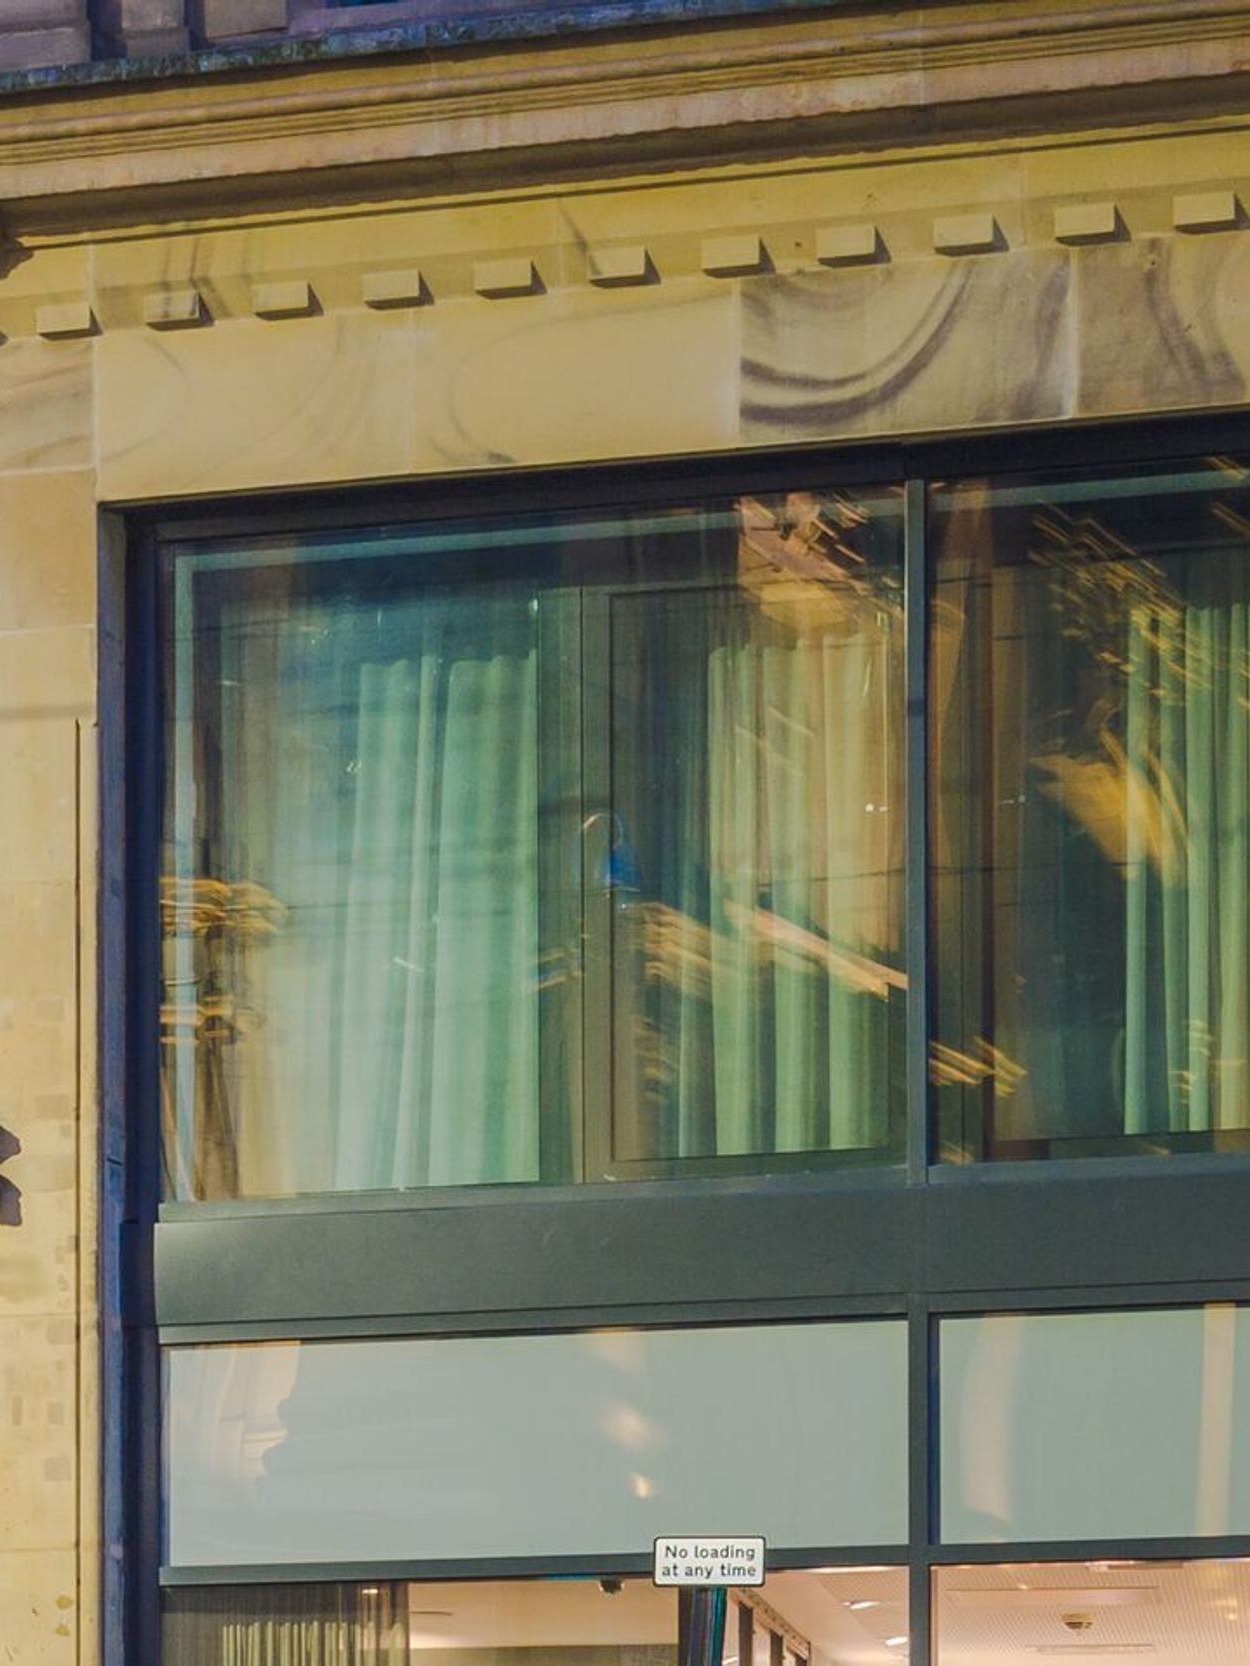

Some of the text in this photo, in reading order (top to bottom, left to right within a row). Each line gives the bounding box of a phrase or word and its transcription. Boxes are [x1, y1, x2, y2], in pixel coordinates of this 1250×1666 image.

[664, 1545, 756, 1561] No loading
[662, 1563, 756, 1579] at any time
